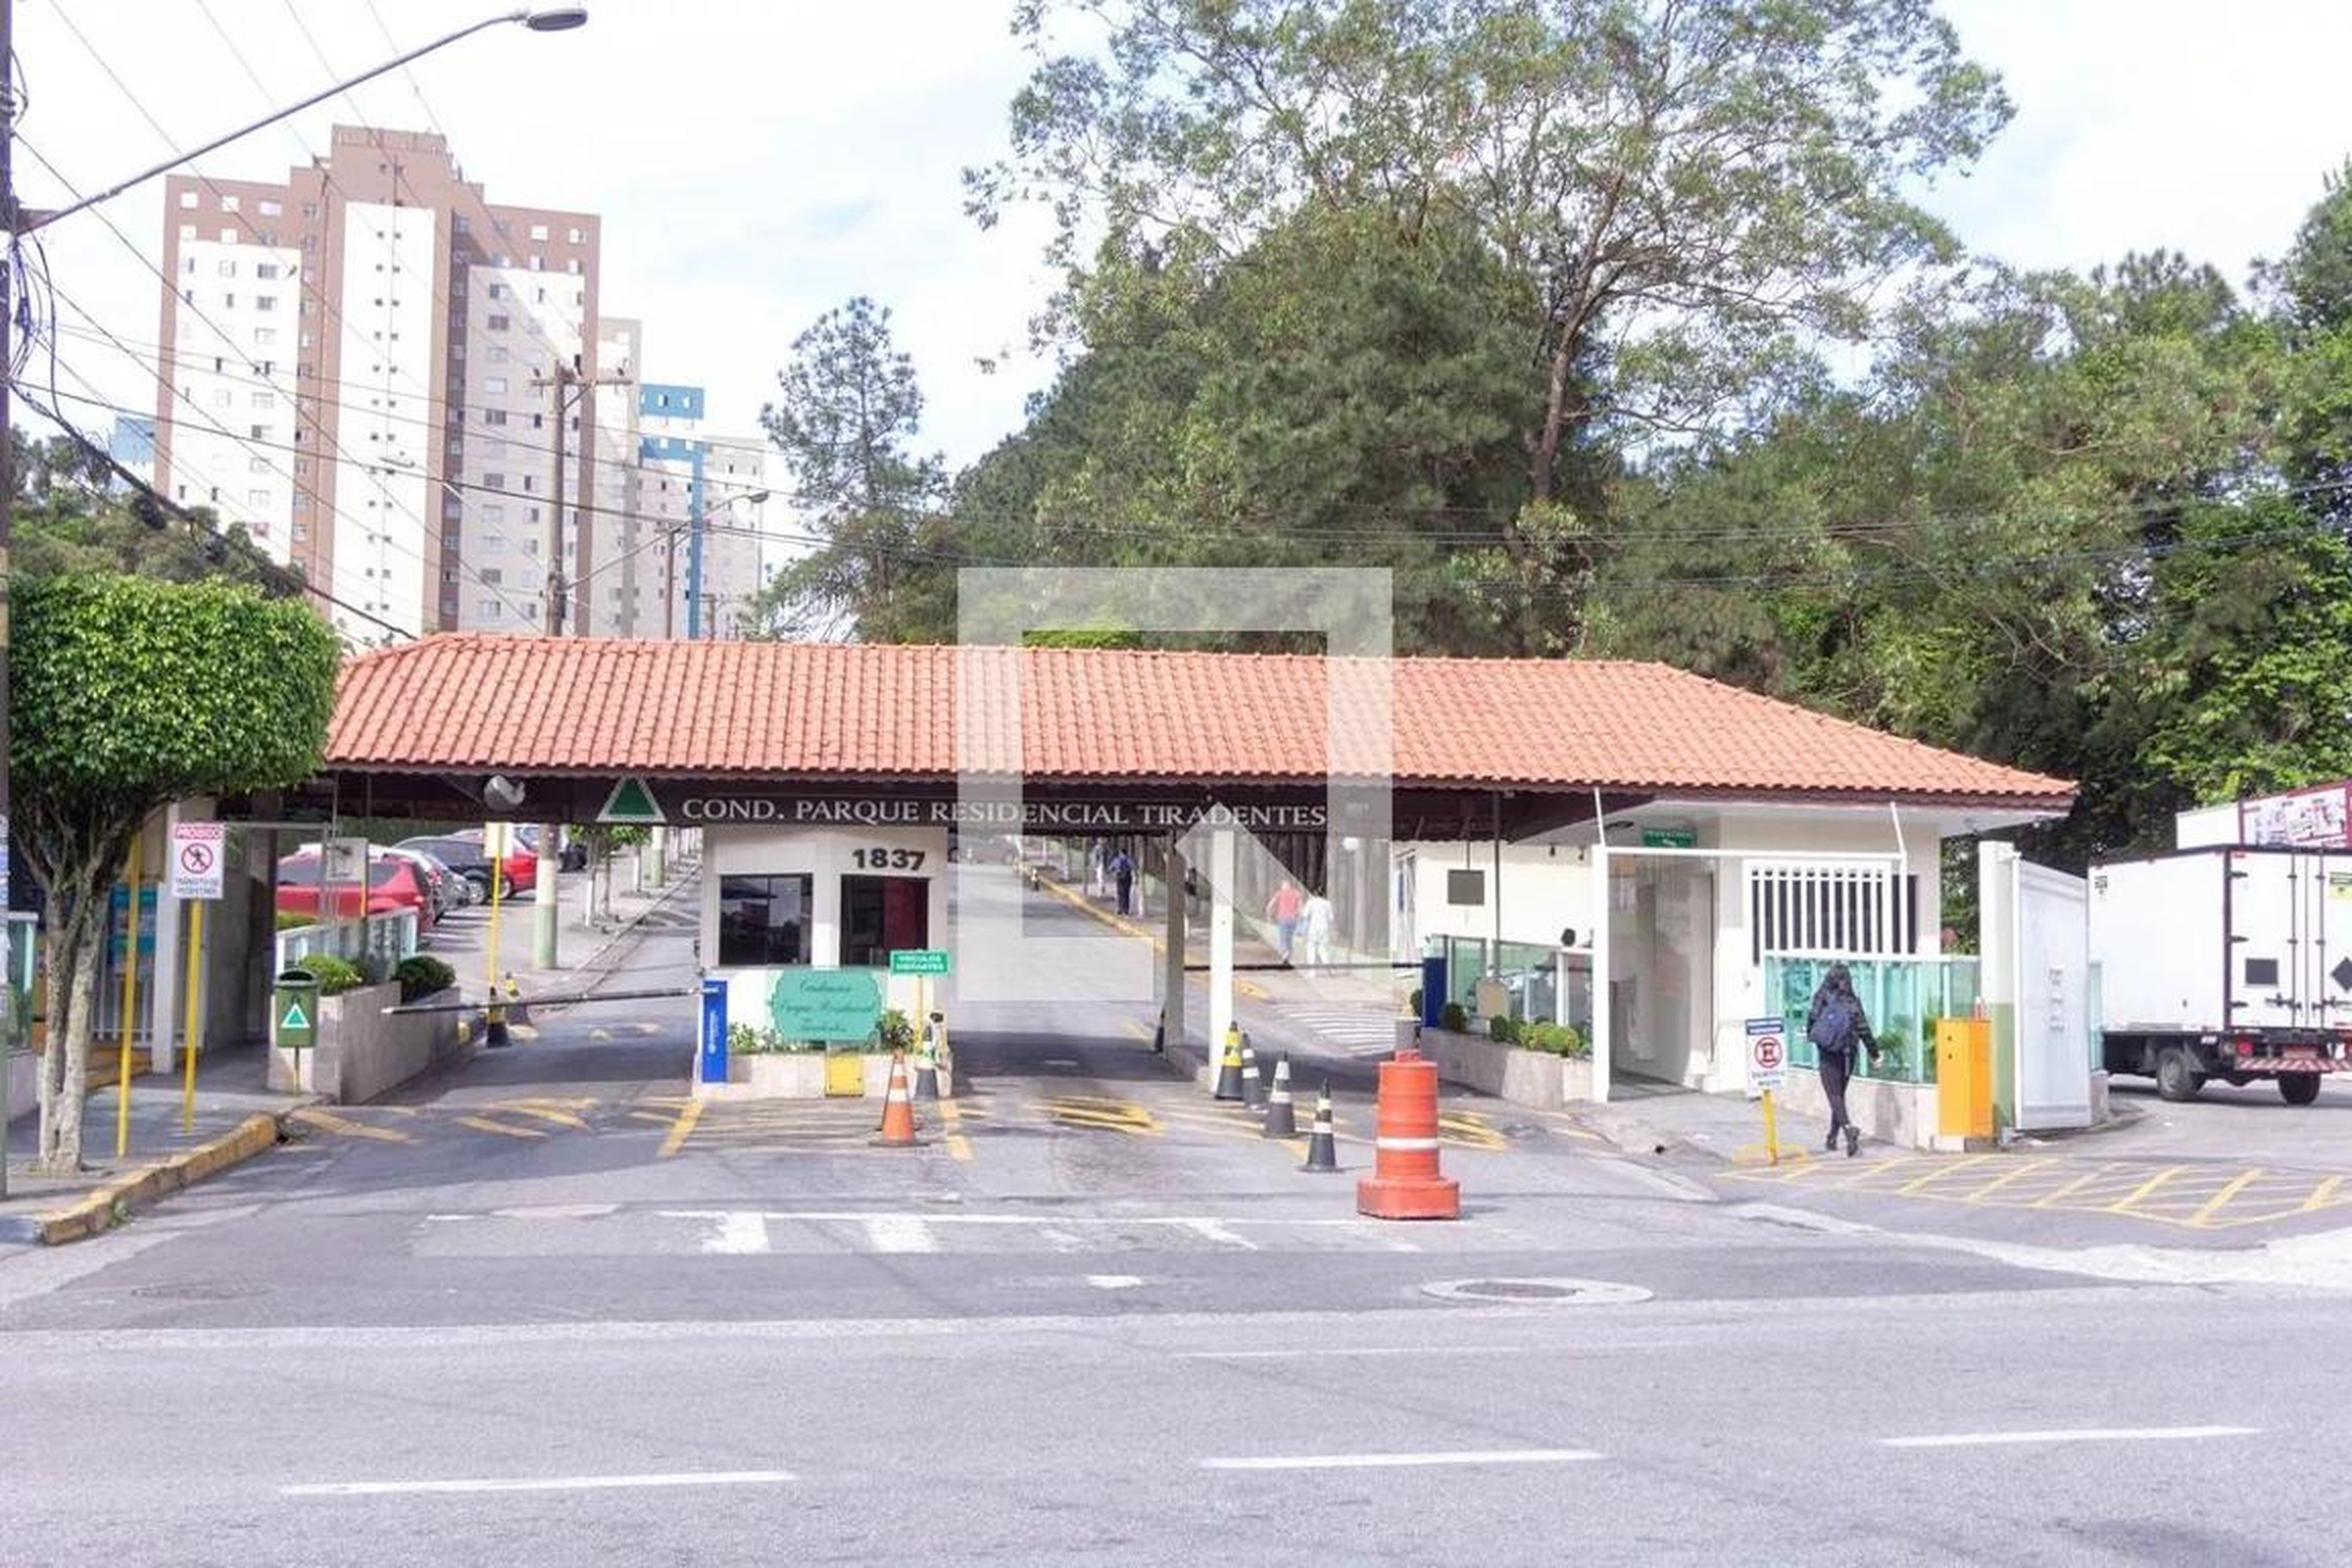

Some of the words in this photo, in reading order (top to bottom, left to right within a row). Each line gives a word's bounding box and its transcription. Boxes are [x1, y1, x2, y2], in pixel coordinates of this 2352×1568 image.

[682, 799, 785, 820] COND.
[796, 800, 919, 825] PARQUE
[930, 801, 1129, 824] RESIDENCIAL
[1136, 804, 1327, 826] TIRADENTES
[853, 848, 925, 870] 1837
